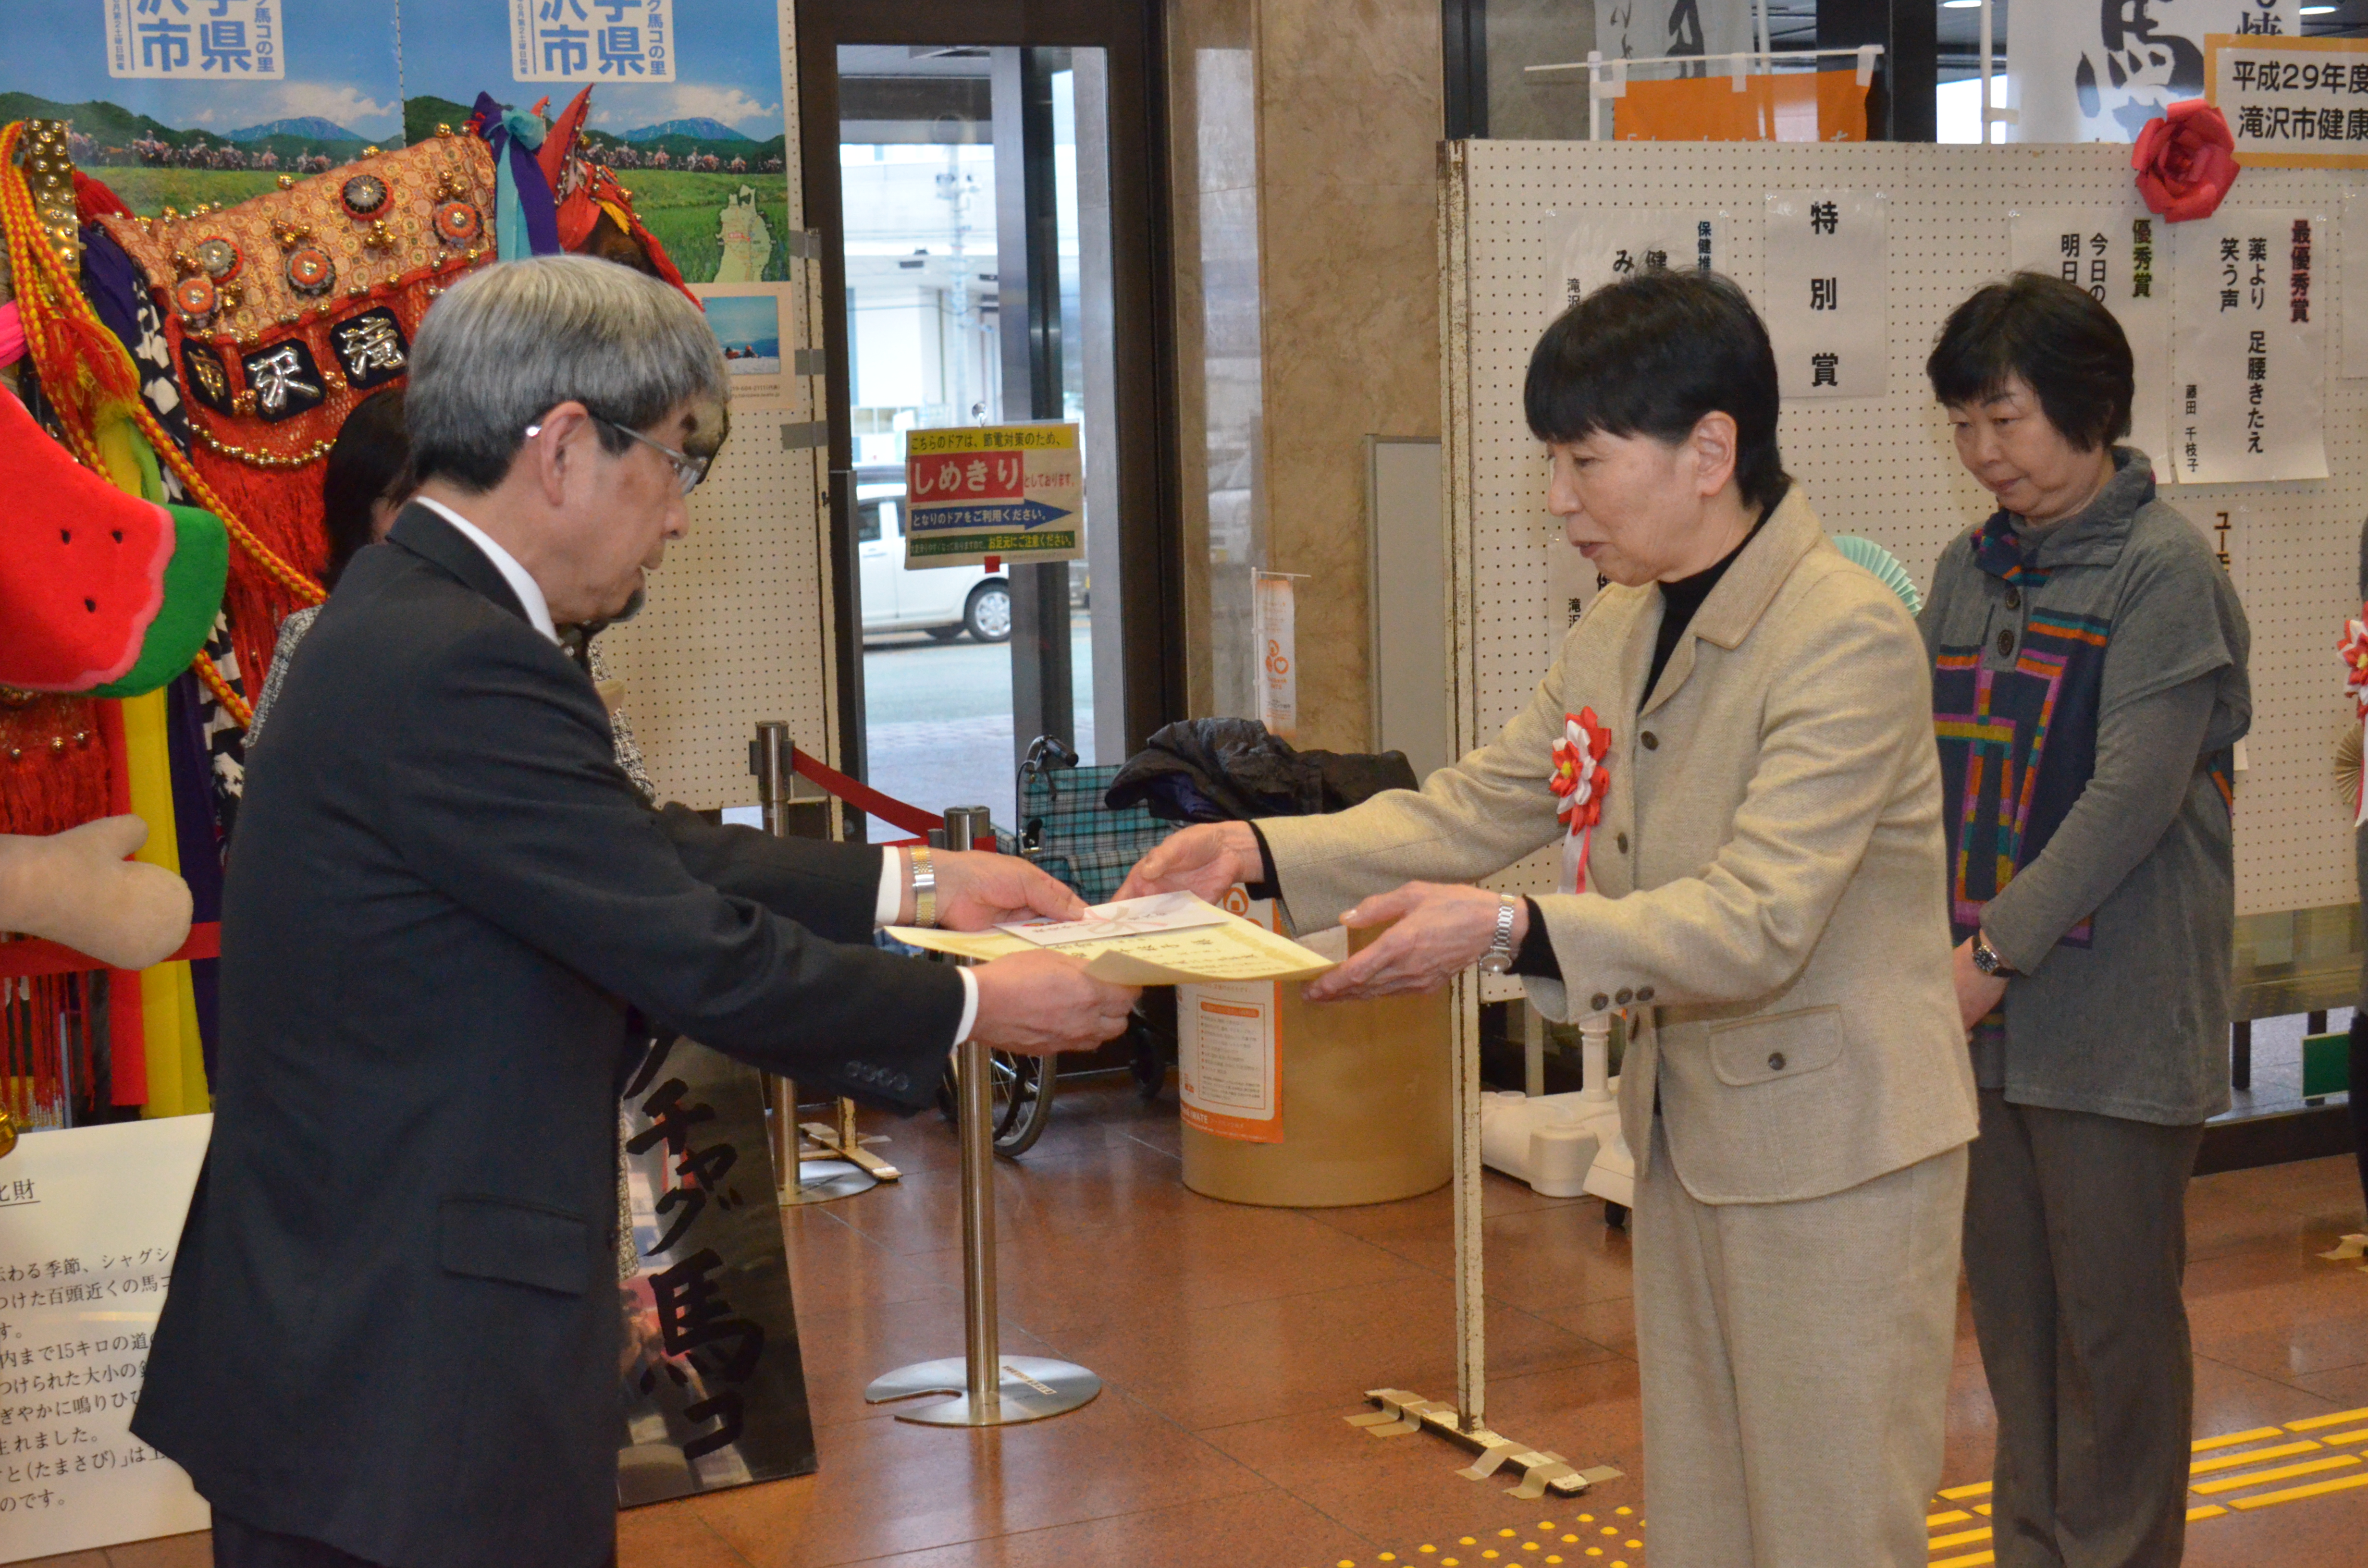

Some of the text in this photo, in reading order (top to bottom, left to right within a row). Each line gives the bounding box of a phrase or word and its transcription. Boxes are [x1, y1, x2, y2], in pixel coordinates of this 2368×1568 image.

[1810, 201, 1838, 387] 特別賞
[2132, 219, 2152, 298] 優秀賞
[2220, 237, 2240, 313] 笑う声
[2291, 219, 2310, 323] 最優秀賞
[2247, 237, 2267, 454] 薬より 足腰きたえ
[911, 431, 1060, 451] こちらのドアは、節電対策のため、
[915, 458, 1019, 495] しめきり
[913, 508, 1047, 527] となりのドアをご利用ください。
